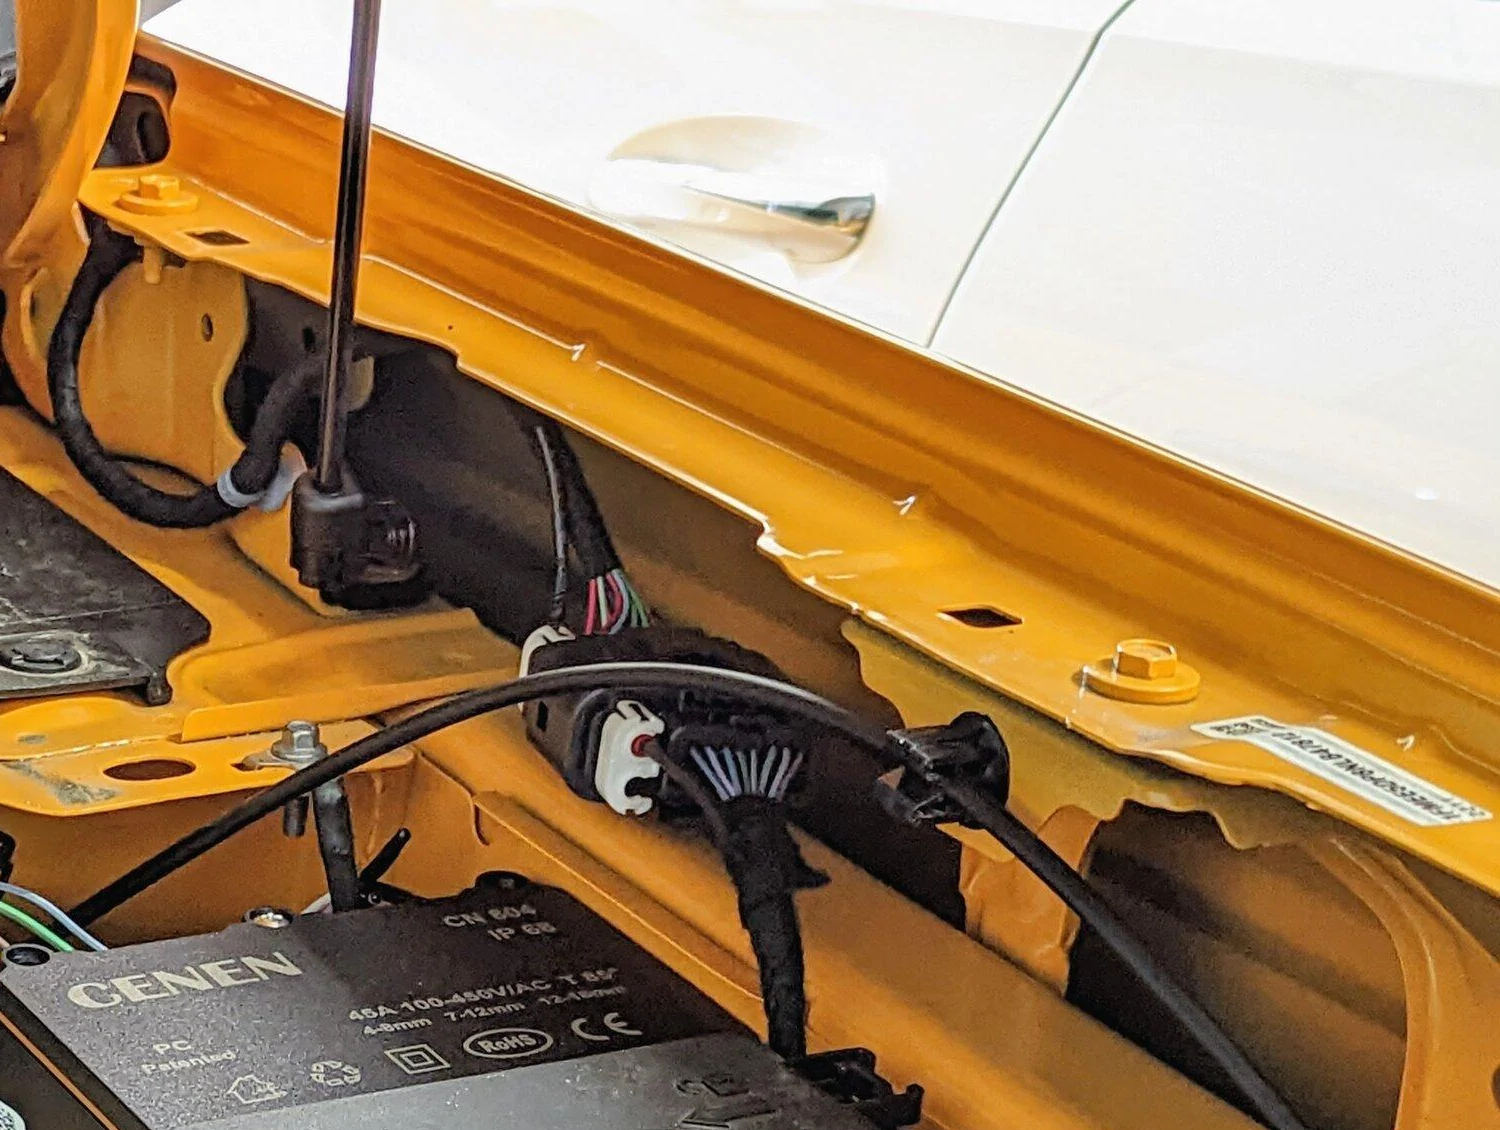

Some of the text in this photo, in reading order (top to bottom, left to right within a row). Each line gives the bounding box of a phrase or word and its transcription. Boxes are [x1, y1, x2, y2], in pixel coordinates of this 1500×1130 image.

[487, 927, 515, 940] IP
[67, 951, 303, 1009] CENEN
[153, 1040, 193, 1055] PC
[477, 1033, 538, 1054] RoHS
